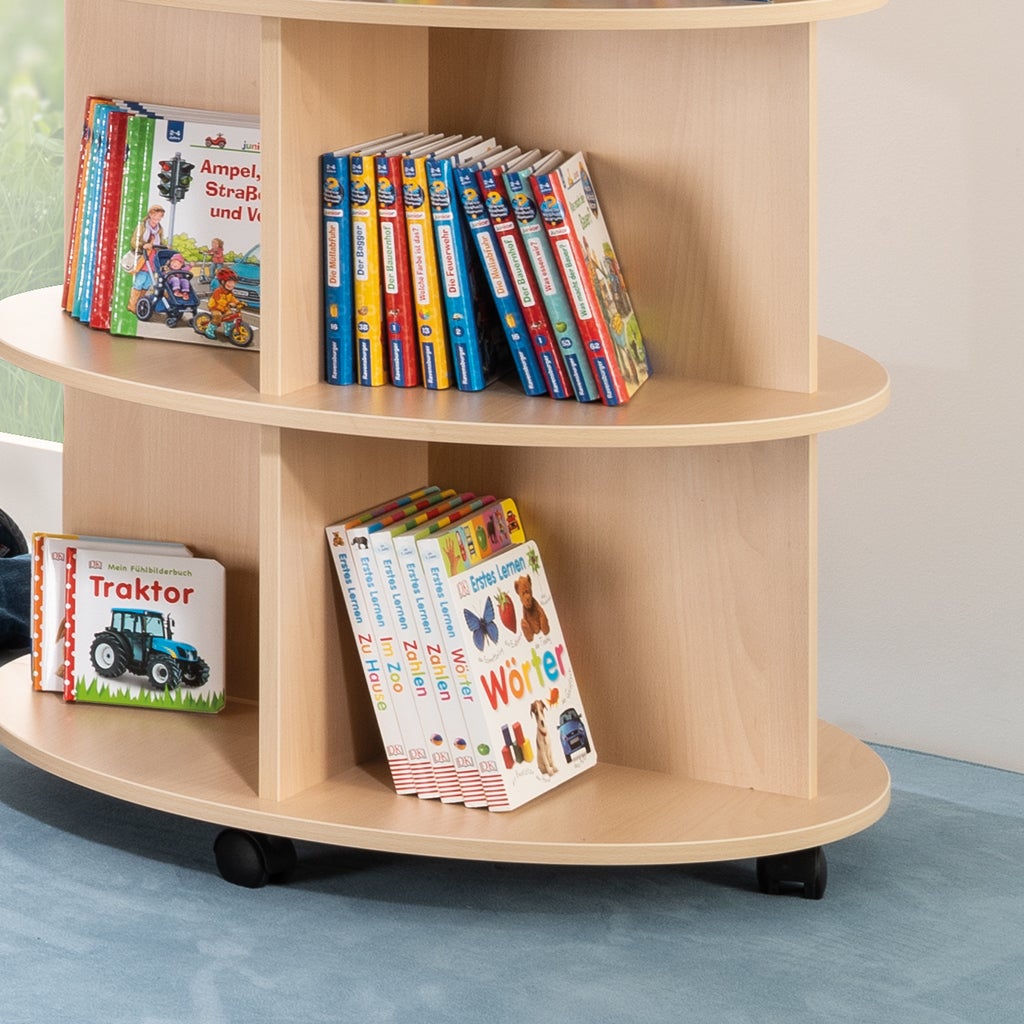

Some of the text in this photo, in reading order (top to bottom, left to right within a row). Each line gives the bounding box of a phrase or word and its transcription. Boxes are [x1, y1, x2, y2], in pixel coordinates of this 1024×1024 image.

[200, 160, 260, 181] Ampel,
[210, 206, 242, 220] und
[356, 226, 365, 257] Bagger
[383, 226, 394, 272] Bauernhof
[412, 228, 420, 244] das?
[441, 229, 456, 276] Feuerwehr
[415, 255, 424, 276] Farbe
[504, 240, 526, 285] Bauernhof
[530, 242, 553, 292] Was essen wir?
[559, 244, 588, 316] Was macht der Bauer?
[418, 276, 426, 302] Welche
[496, 280, 505, 294] Die
[524, 286, 532, 304] Der
[392, 342, 400, 380] Ravensburger
[425, 346, 433, 384] Ravensburger
[458, 346, 468, 384] Ravensburger
[518, 352, 534, 390] Ravensburger
[544, 355, 559, 392] Ravensburger
[569, 358, 584, 396] Ravensburger
[597, 360, 612, 399] Ravensburger
[108, 564, 192, 577] Mein Fühlbilderbuch
[338, 553, 363, 624] Erstes Lernen
[470, 556, 526, 594] Erstes Lernen
[89, 576, 194, 604] Traktor
[360, 556, 385, 627] Erstes Lernen
[383, 559, 398, 591] Erstes
[392, 593, 408, 630] Lernen
[406, 563, 420, 594] Erstes
[416, 597, 432, 634] Lernen
[430, 567, 445, 598] Erstes
[440, 601, 456, 638] Lernen
[358, 633, 387, 711] Zu Hause
[380, 637, 404, 693] Im Zoo
[403, 640, 428, 697] Zahlen
[426, 644, 451, 701] Zahlen
[451, 648, 474, 702] Wörter
[480, 644, 566, 711] Wörter
[388, 744, 404, 756] DK
[410, 748, 426, 760] DK
[434, 752, 449, 763] DK
[458, 756, 472, 767] DK
[481, 761, 496, 772] DK
